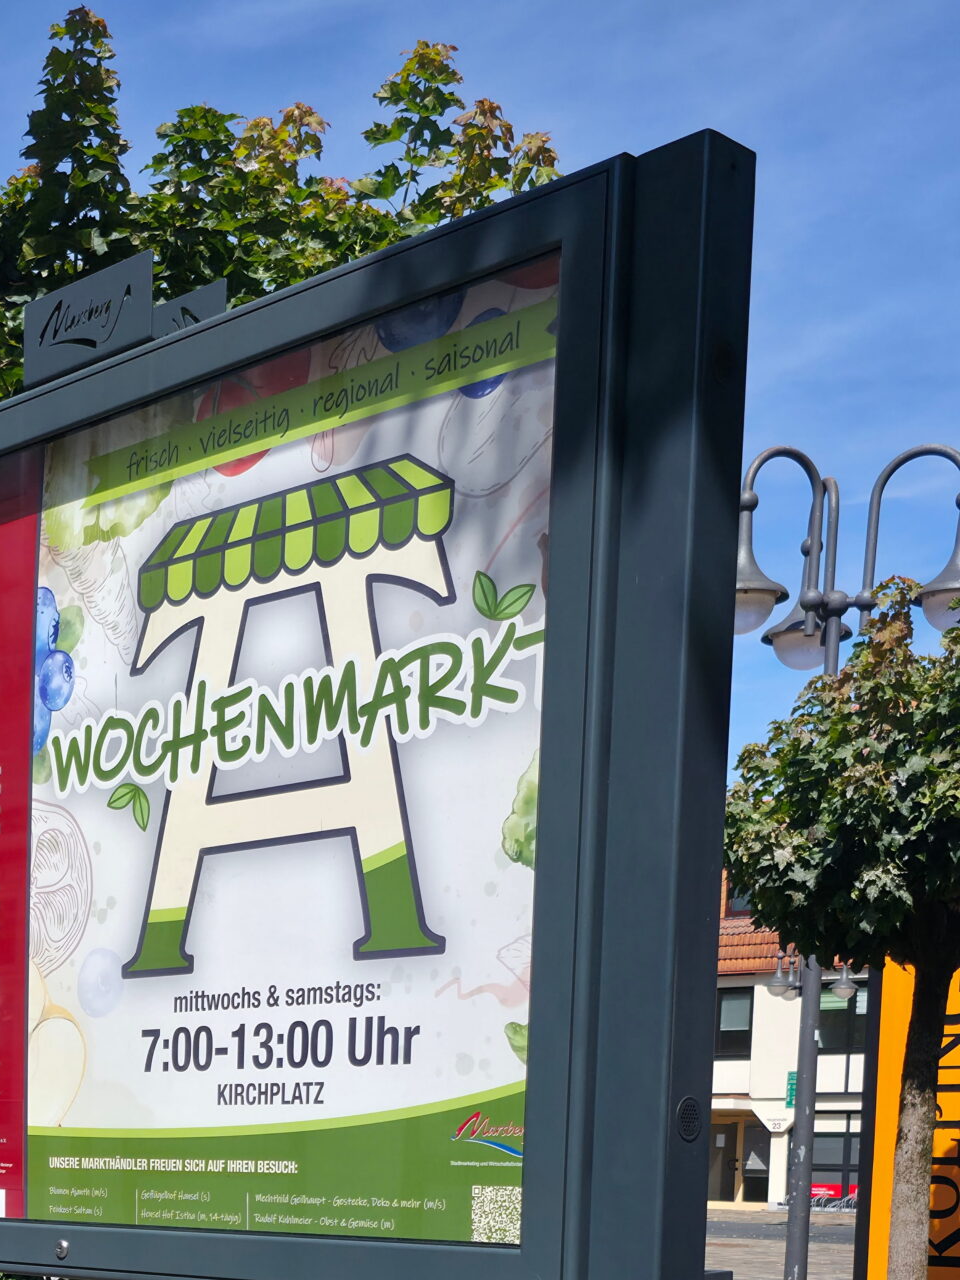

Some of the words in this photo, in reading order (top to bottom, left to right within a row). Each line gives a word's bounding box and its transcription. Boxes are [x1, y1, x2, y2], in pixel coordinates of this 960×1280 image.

[128, 442, 178, 480] frisch
[200, 406, 290, 454] vielseitig
[312, 363, 401, 420] regional
[425, 320, 520, 380] saisonal
[174, 987, 260, 1013] mittwochs
[268, 985, 280, 1006] &
[285, 981, 381, 1007] samstags:
[141, 1019, 334, 1072] 7:00-13:00
[348, 1016, 420, 1066] Uhr
[217, 1082, 324, 1106] KIRCHPLATZ
[49, 1157, 79, 1168] UNSERE
[82, 1156, 148, 1170] MARKTHÄNDLER
[150, 1159, 182, 1171] FREUEN
[184, 1160, 206, 1172] SICH
[207, 1160, 225, 1172] AUF
[227, 1160, 255, 1173] IHREN
[257, 1161, 298, 1174] BESUCH:
[91, 1188, 108, 1198] (m/s)
[141, 1190, 177, 1202] Geflügelhof
[201, 1192, 210, 1202] (s)
[255, 1194, 289, 1203] Mechthild
[290, 1194, 326, 1207] Geilhaupt
[333, 1196, 370, 1208] Gestecke,
[372, 1198, 390, 1207] Deko
[400, 1200, 420, 1208] mehr
[423, 1199, 446, 1210] (m/s)
[94, 1206, 103, 1216] (s)
[162, 1209, 174, 1218] Hof
[254, 1213, 277, 1224] Rudolf
[279, 1214, 312, 1225] Kuhlmeier
[320, 1217, 338, 1226] Obst
[348, 1218, 378, 1228] Gemüse
[380, 1219, 394, 1230] (m)
